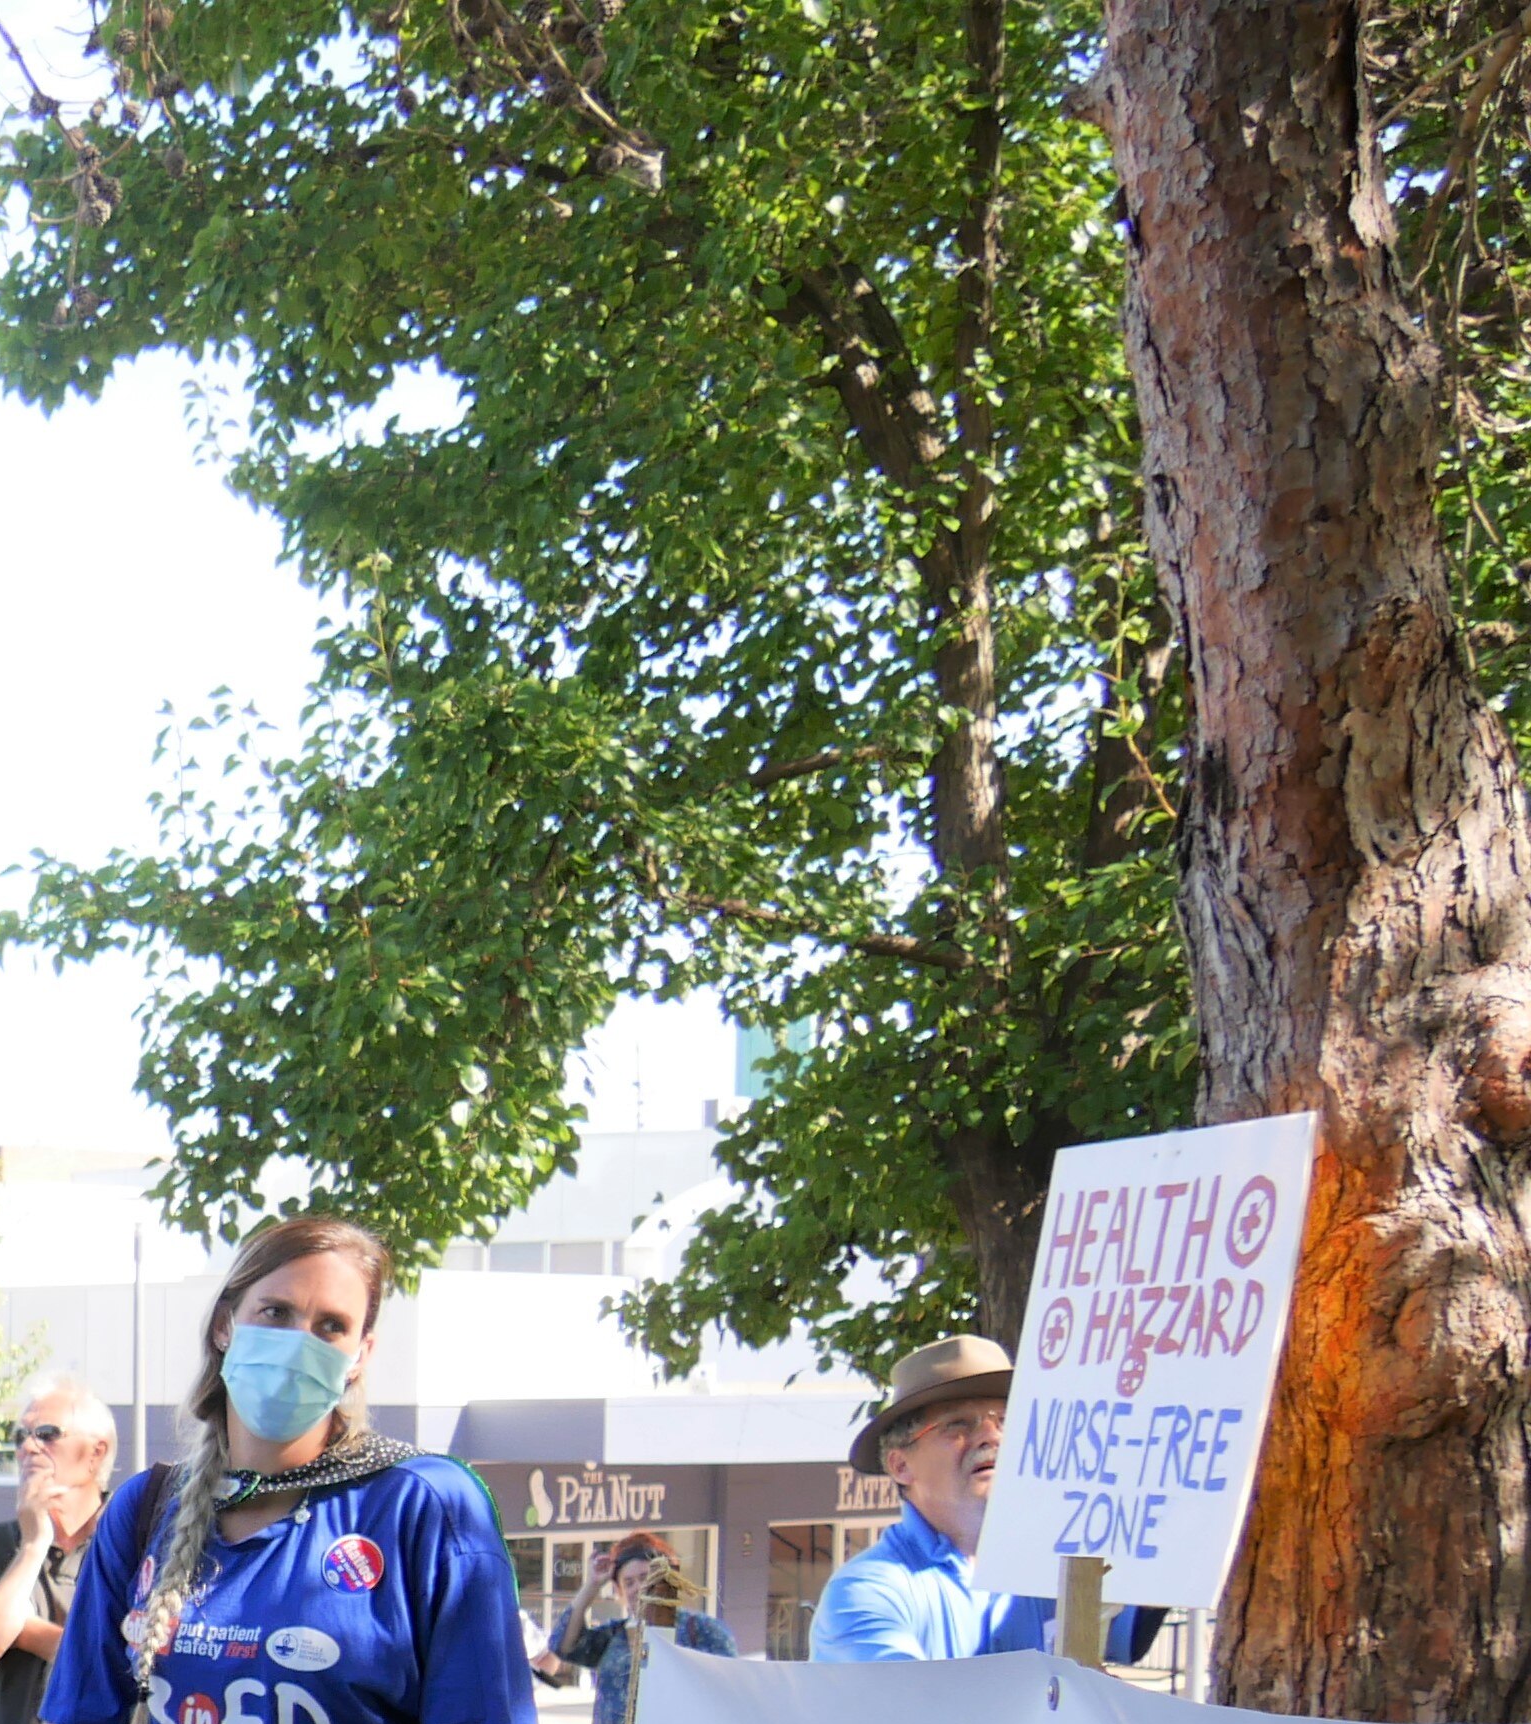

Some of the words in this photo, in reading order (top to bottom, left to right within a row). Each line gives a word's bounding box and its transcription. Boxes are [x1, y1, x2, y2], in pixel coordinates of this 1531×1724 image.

[1042, 1174, 1221, 1288] HEALTH
[1079, 1279, 1264, 1365] HAZZARD
[583, 1472, 603, 1485] THE
[1018, 1398, 1242, 1492] NURSE-FREE
[1054, 1491, 1167, 1559] ZONE
[173, 1637, 223, 1660] safety
[224, 1641, 259, 1659] first
[177, 1622, 204, 1638] put
[207, 1625, 262, 1643] patient
